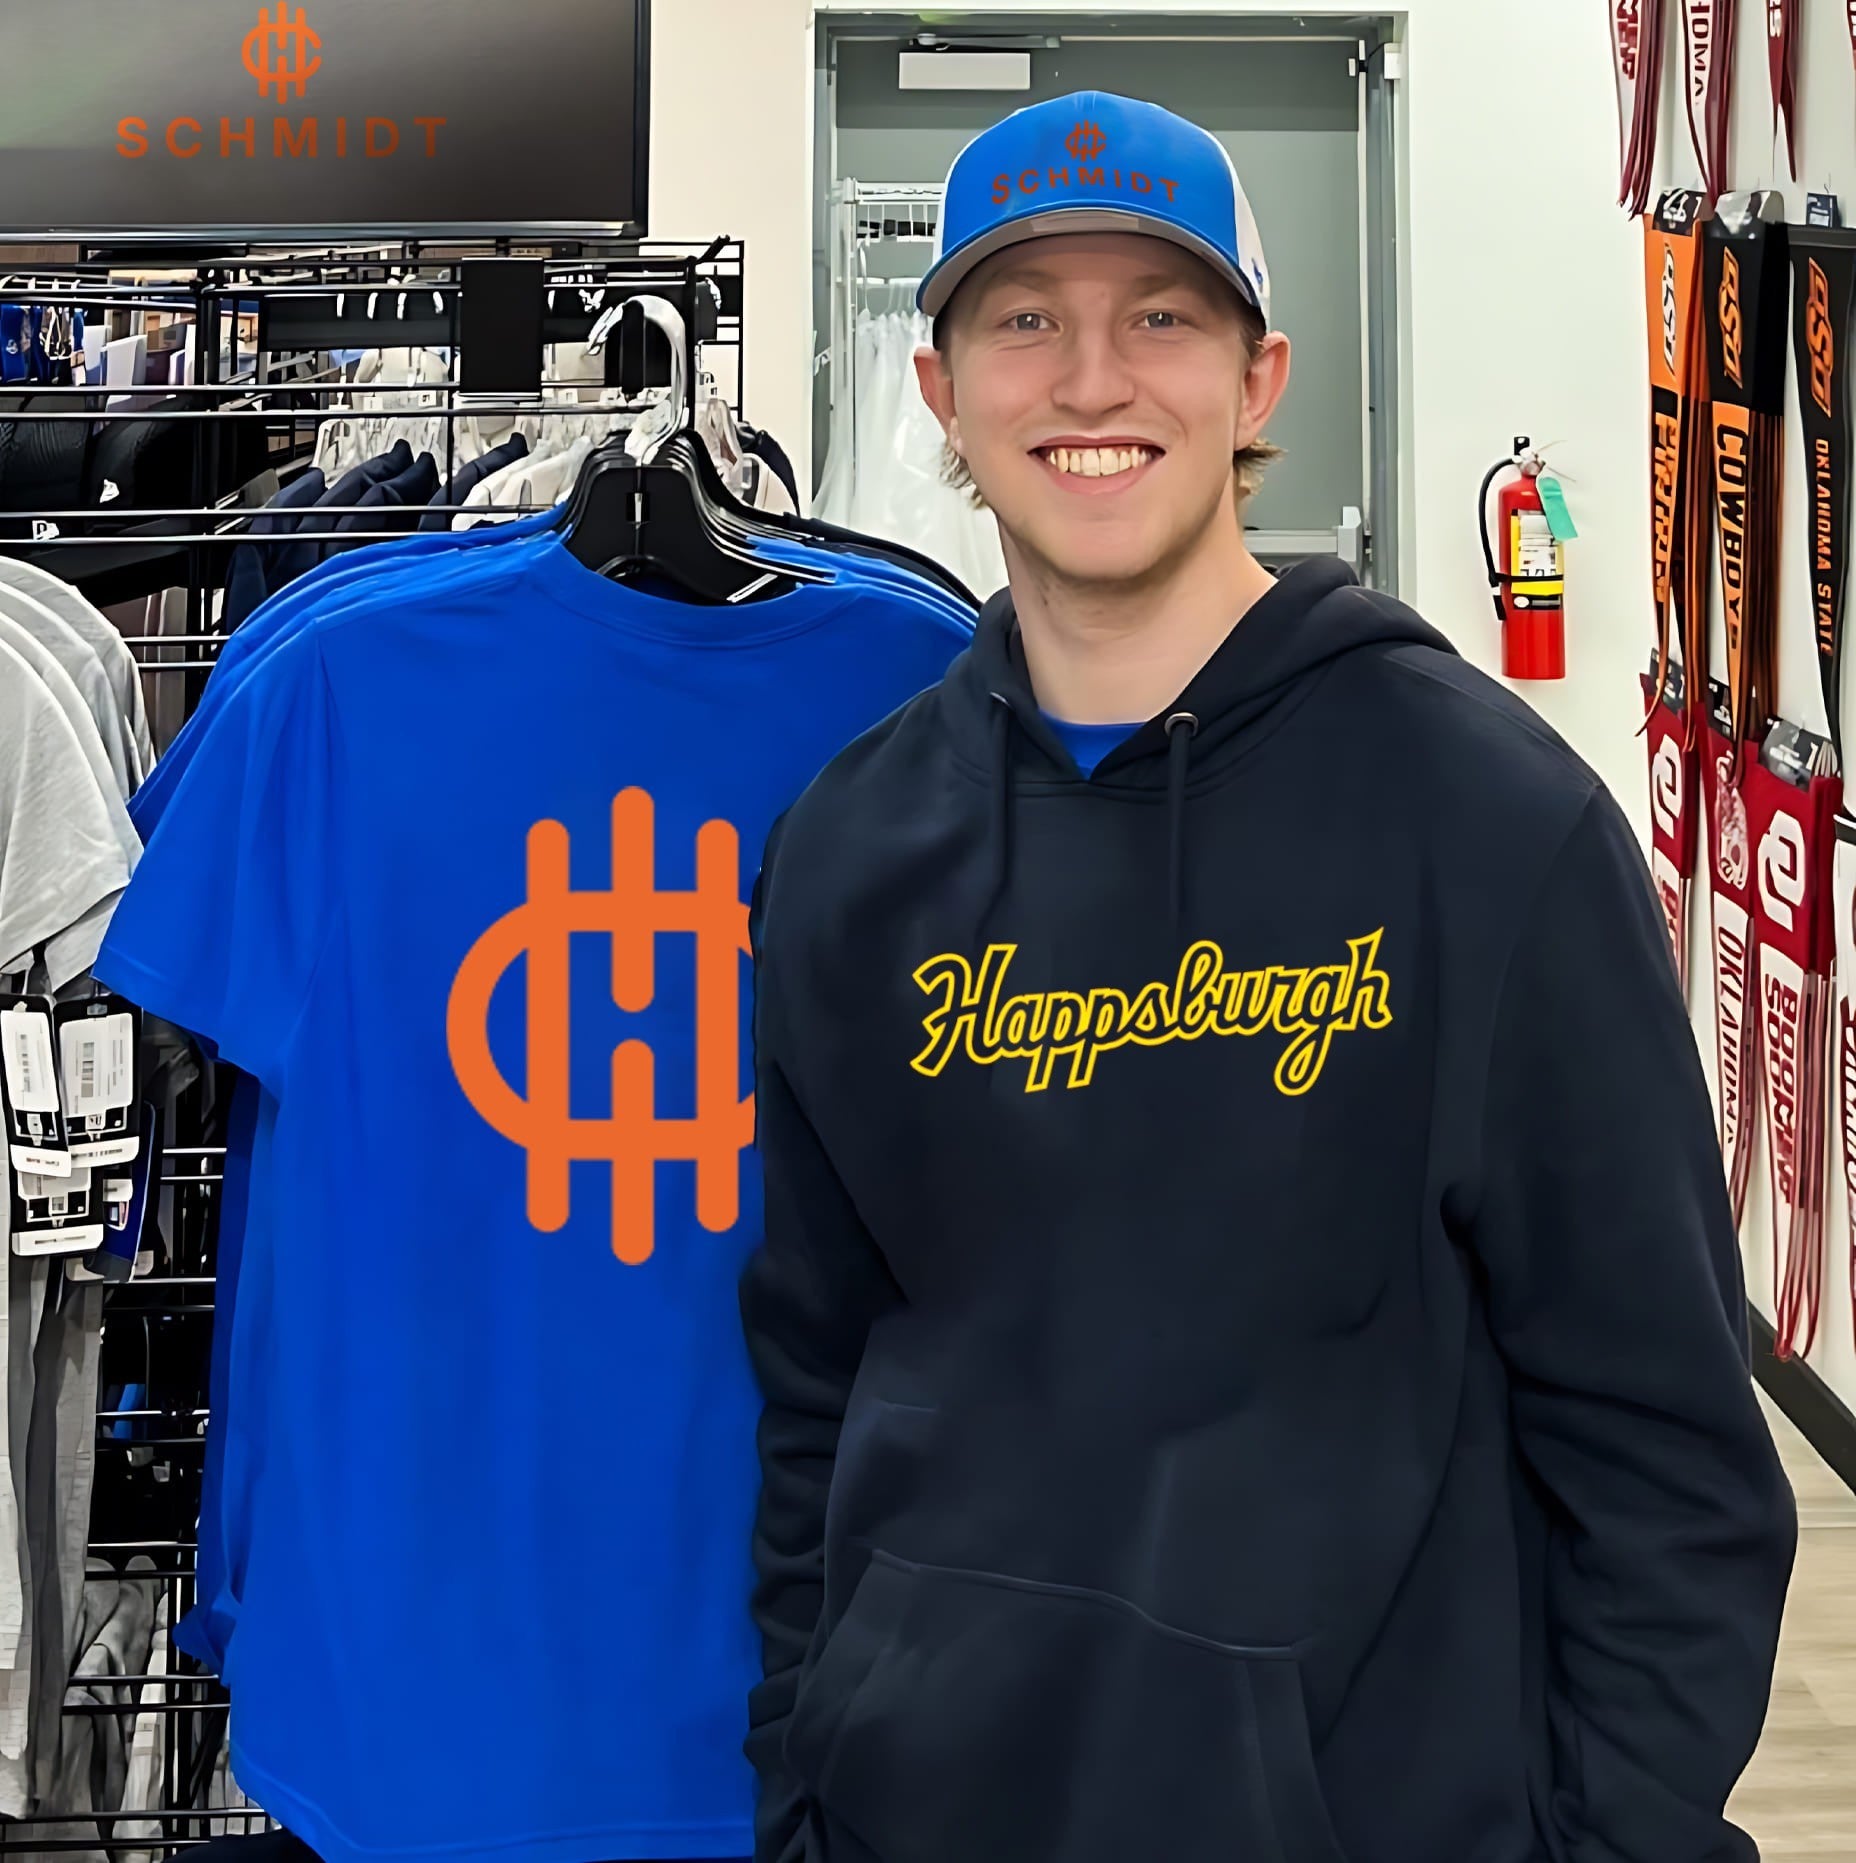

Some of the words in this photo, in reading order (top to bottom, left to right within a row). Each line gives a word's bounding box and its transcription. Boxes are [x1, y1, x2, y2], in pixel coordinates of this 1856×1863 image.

[115, 116, 448, 158] SCHMIDT
[992, 166, 1179, 204] SCHMIDT
[1815, 438, 1833, 571] OKLAHOMA
[910, 927, 1393, 1096] Happsburgh
[1718, 926, 1744, 1144] OKLAHOMA
